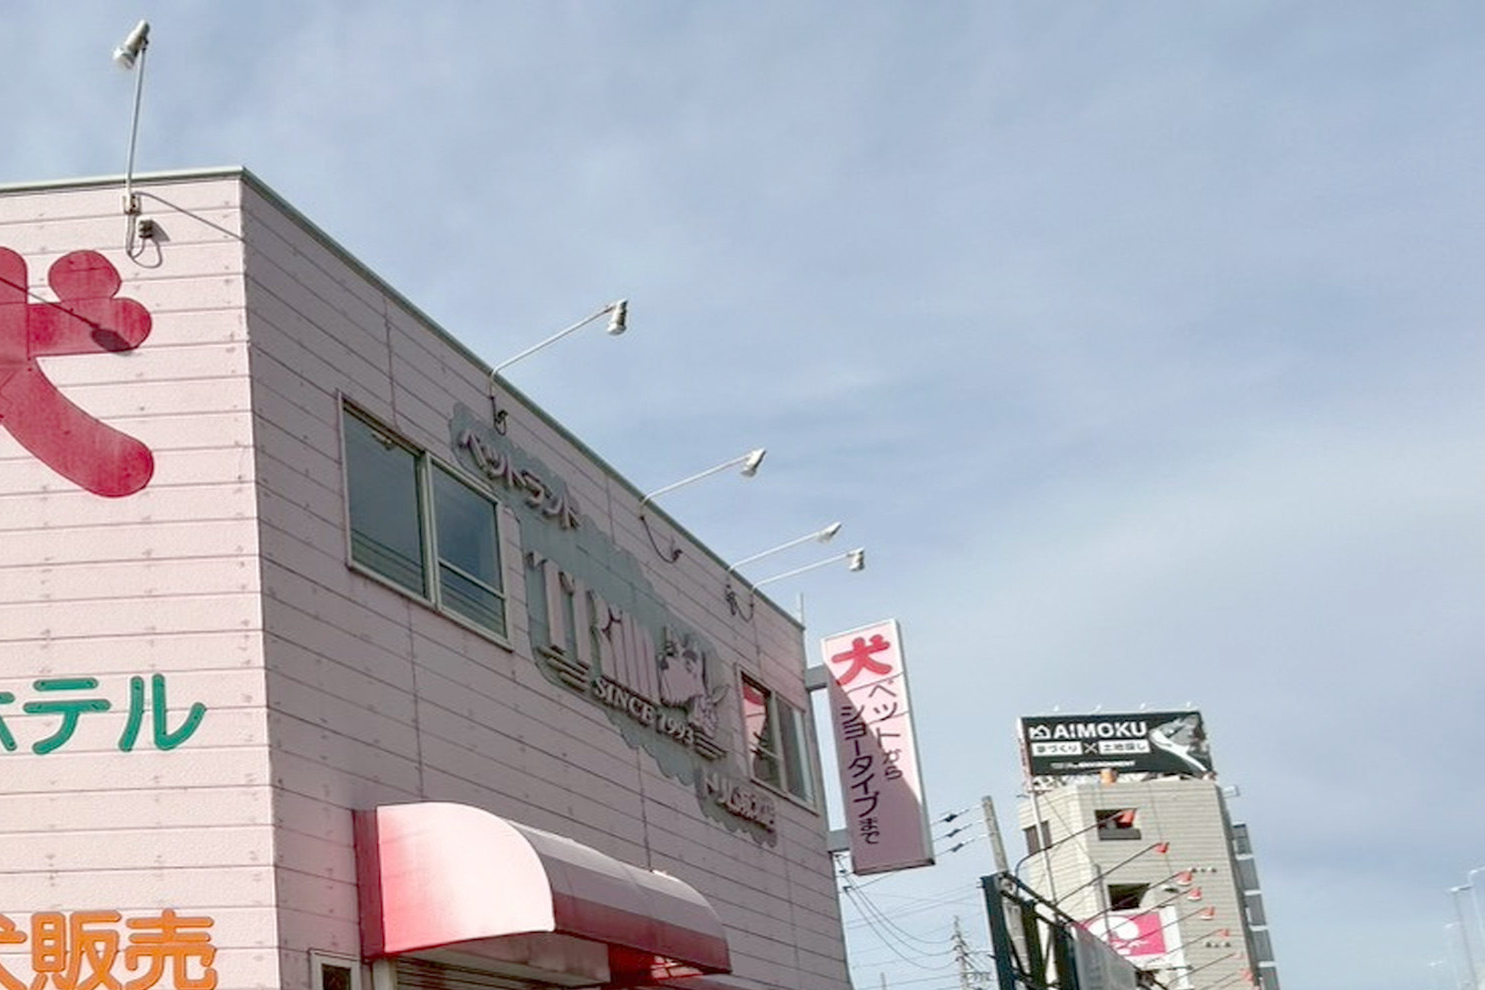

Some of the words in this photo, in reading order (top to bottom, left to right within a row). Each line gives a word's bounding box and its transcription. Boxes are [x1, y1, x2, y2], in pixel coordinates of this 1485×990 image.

[831, 634, 893, 687] 犬
[594, 674, 656, 730] SINCE
[657, 710, 695, 748] 1993
